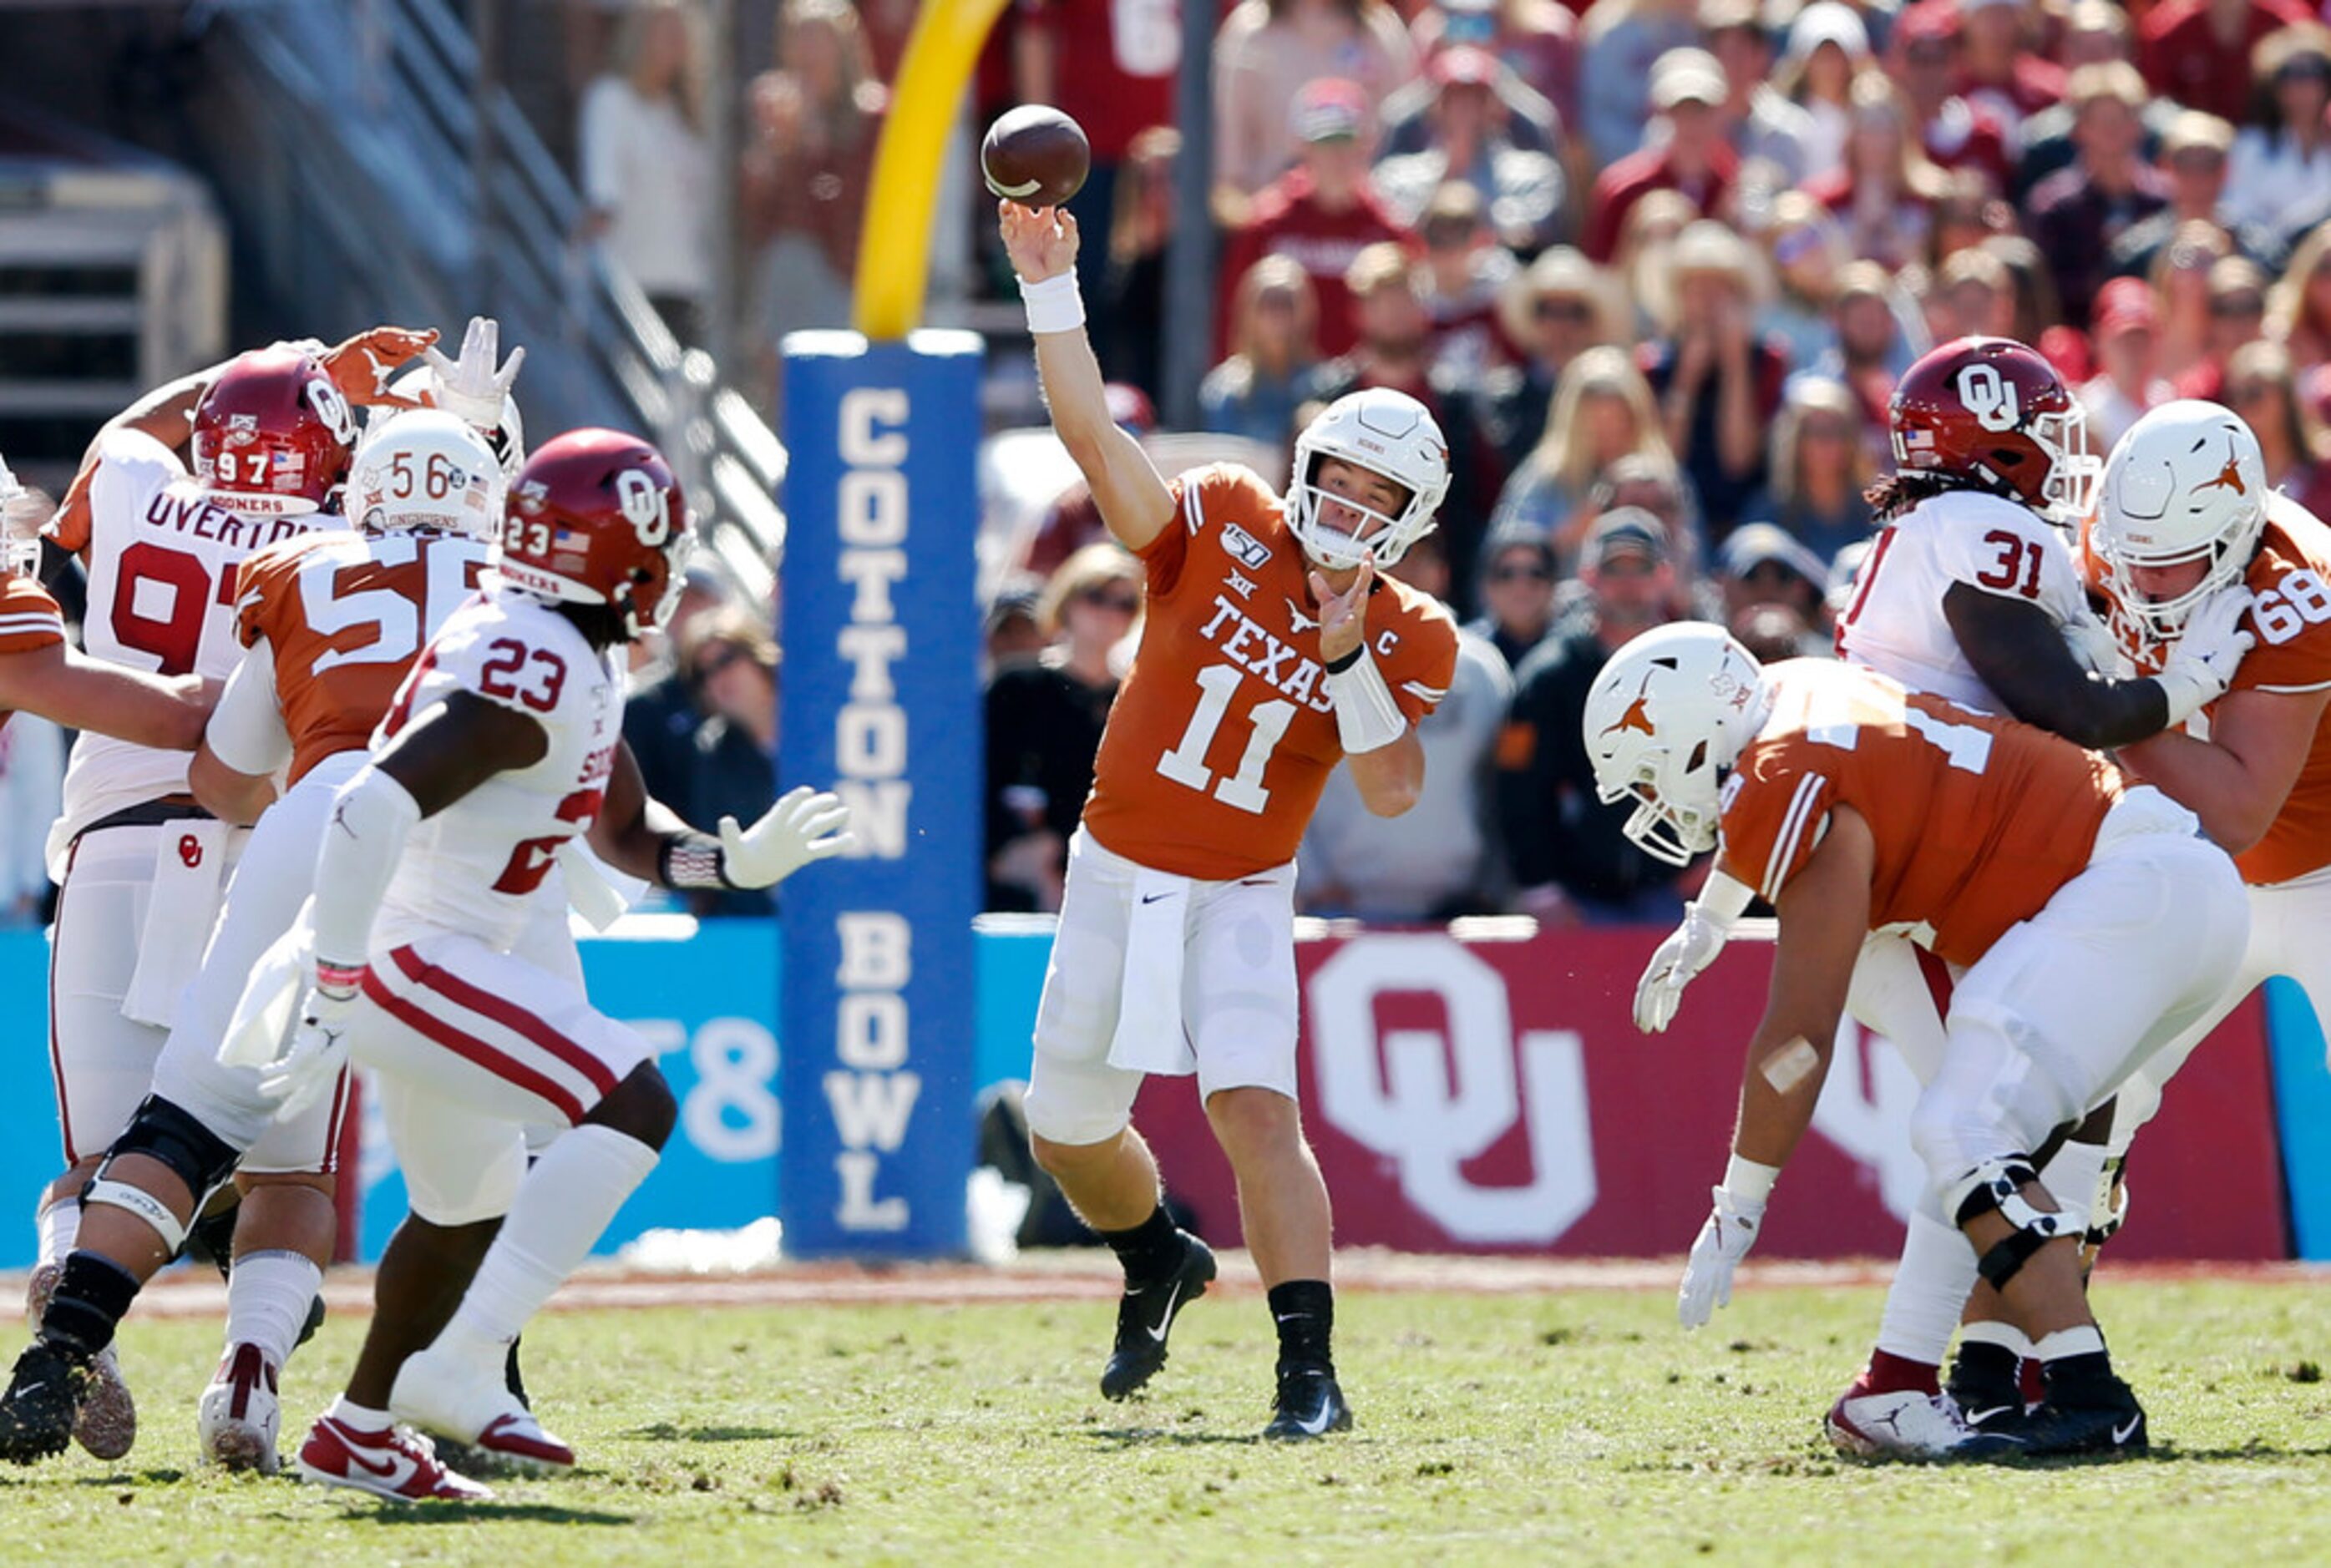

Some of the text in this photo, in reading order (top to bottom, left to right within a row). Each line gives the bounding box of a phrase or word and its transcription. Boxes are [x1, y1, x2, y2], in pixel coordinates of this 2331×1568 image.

[306, 377, 355, 446] OU
[1956, 362, 2020, 432] OU
[217, 452, 270, 485] 97
[392, 452, 448, 500] 56
[505, 515, 550, 558] 23
[616, 468, 669, 548] OU
[1220, 524, 1273, 569] 150
[1976, 529, 2044, 599] 31
[1222, 567, 1258, 600] XII
[2252, 569, 2331, 645] 68
[479, 637, 568, 713] 23
[1200, 594, 1336, 713] TEXAS
[1376, 630, 1398, 655] C
[1155, 664, 1298, 815] 11
[823, 387, 921, 1232] COTTON BOWL
[178, 833, 203, 868] OU
[1308, 933, 1597, 1243] OU
